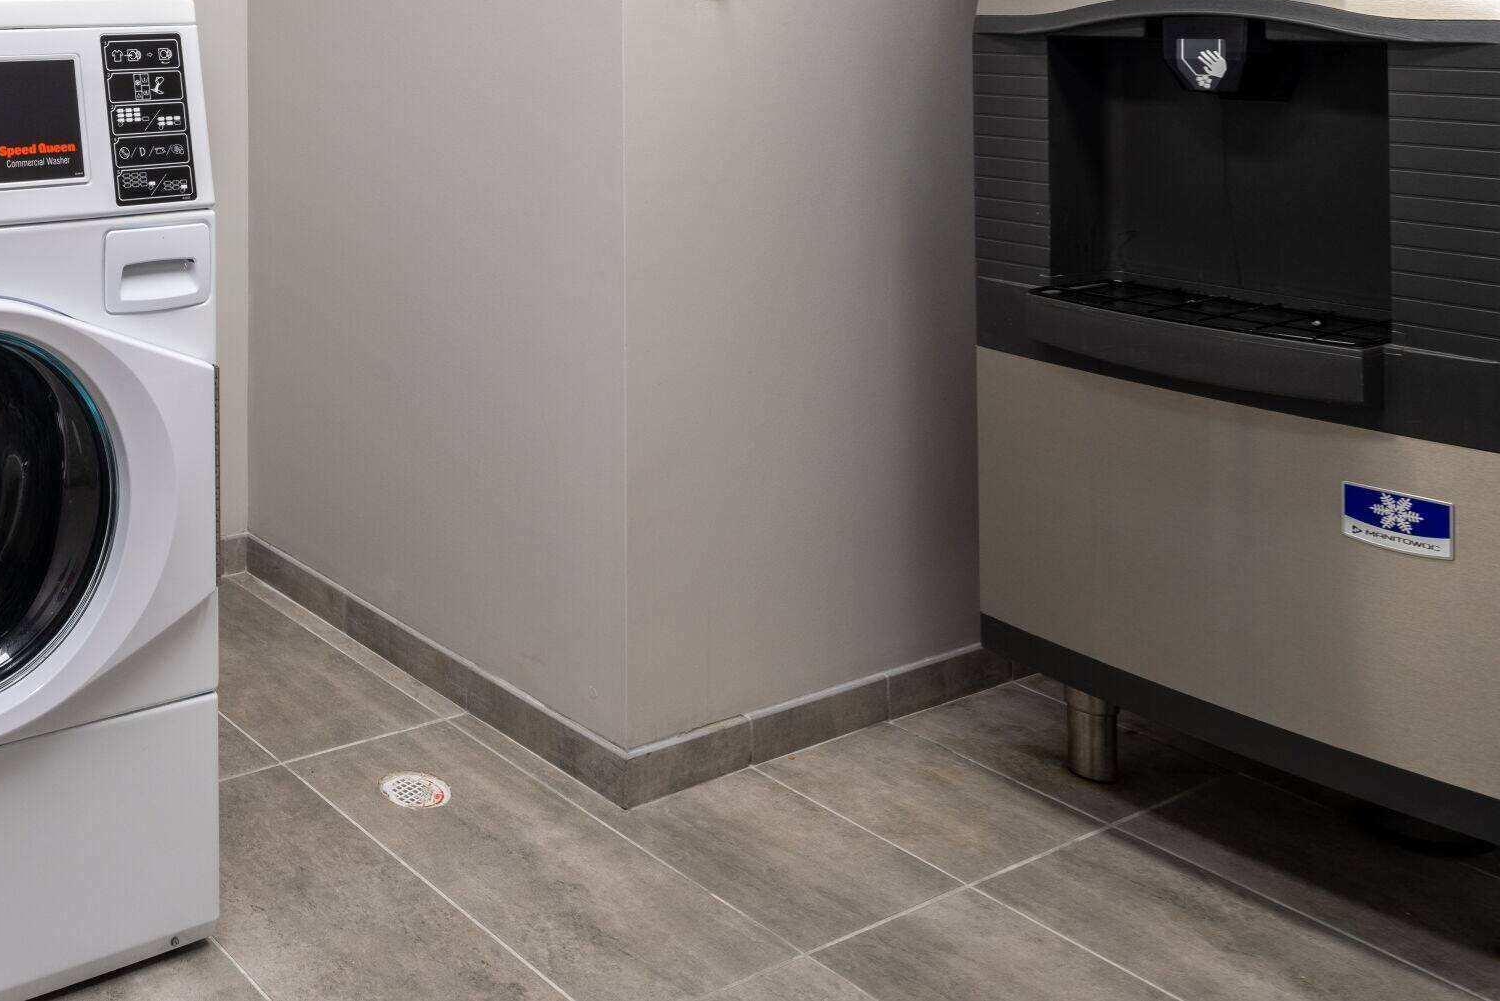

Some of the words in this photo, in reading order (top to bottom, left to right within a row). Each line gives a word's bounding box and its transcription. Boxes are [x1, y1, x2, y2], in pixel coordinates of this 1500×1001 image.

[38, 143, 76, 153] Queen
[6, 158, 44, 168] Commercial
[46, 156, 70, 165] Washer
[1364, 530, 1440, 552] MANITOWOC
